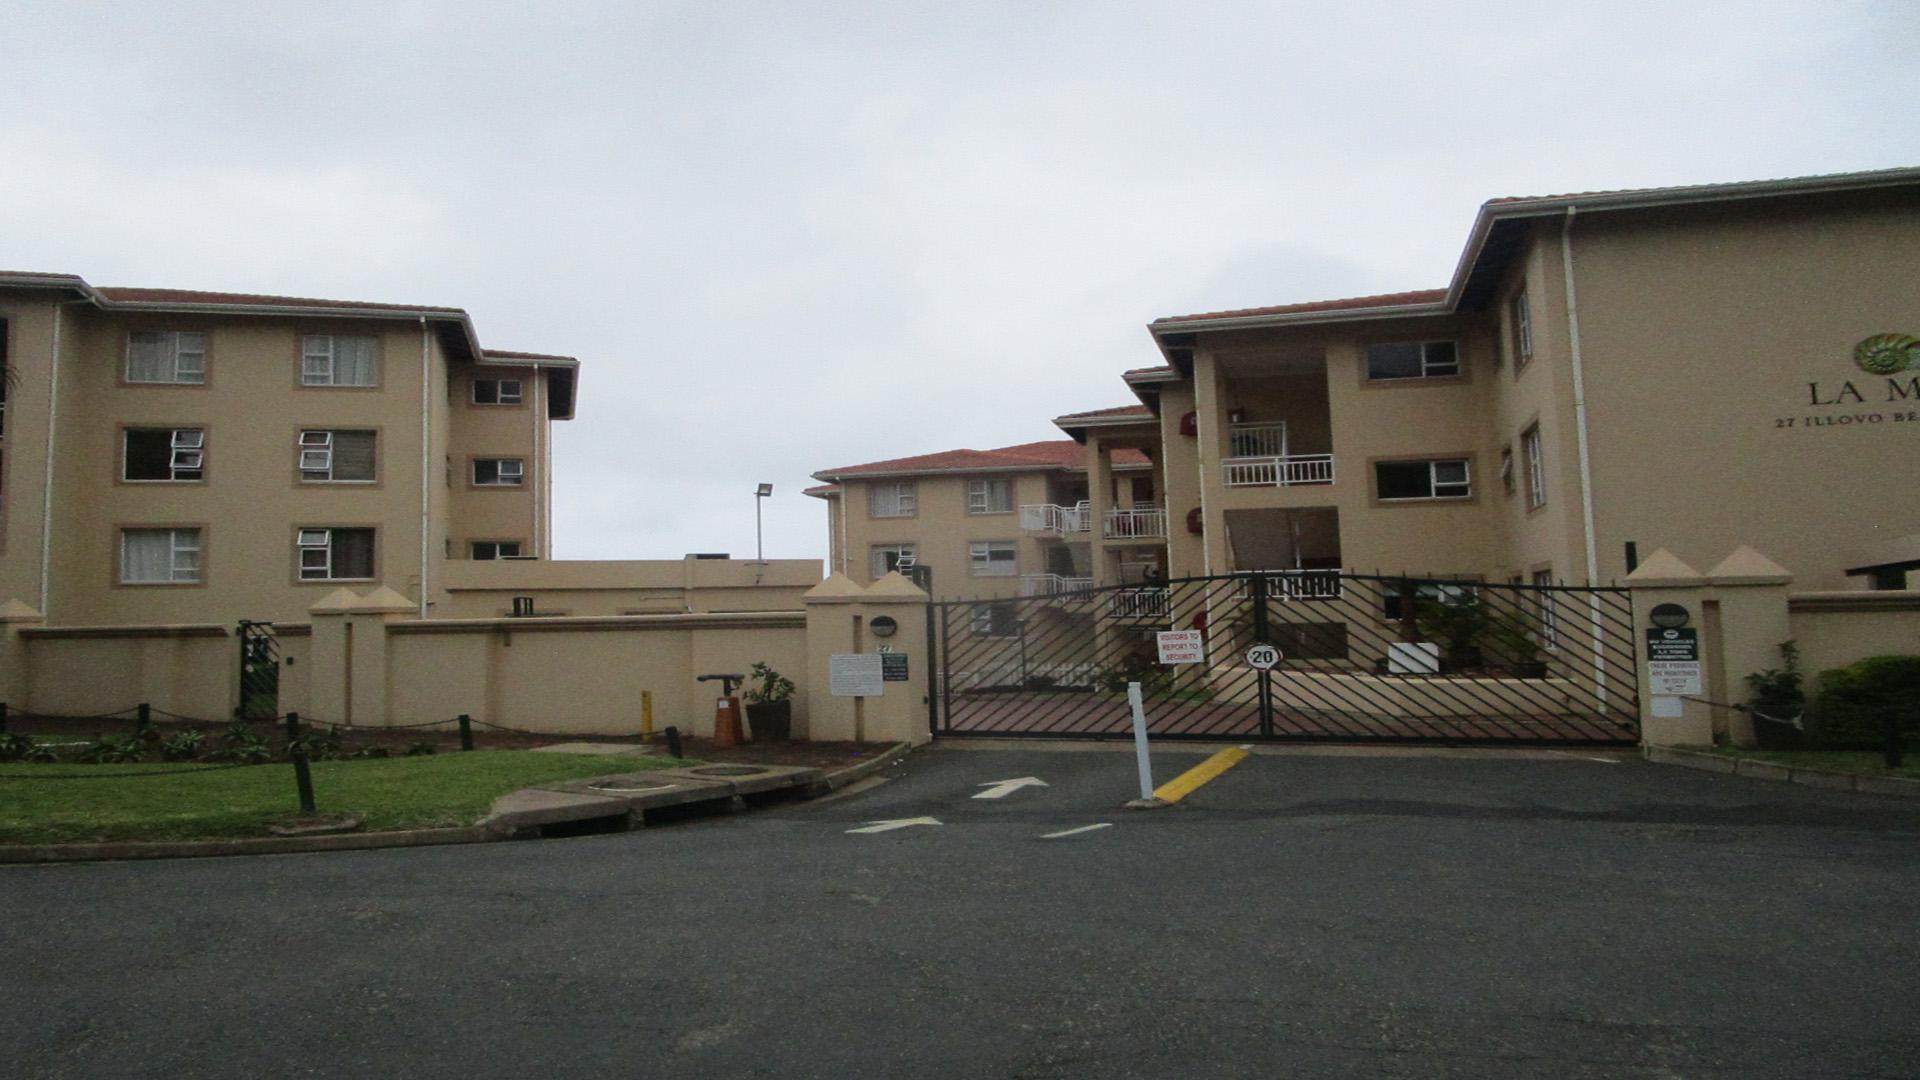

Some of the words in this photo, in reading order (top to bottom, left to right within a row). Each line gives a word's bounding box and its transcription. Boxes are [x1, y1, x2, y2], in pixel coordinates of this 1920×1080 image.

[1808, 381, 1864, 405] LA
[1775, 418, 1795, 428] 27
[1805, 414, 1882, 427] ILLOVO
[1160, 633, 1189, 641] VISITORS
[1190, 632, 1199, 640] TO
[1162, 643, 1188, 651] REPORT
[1252, 650, 1273, 664] 20
